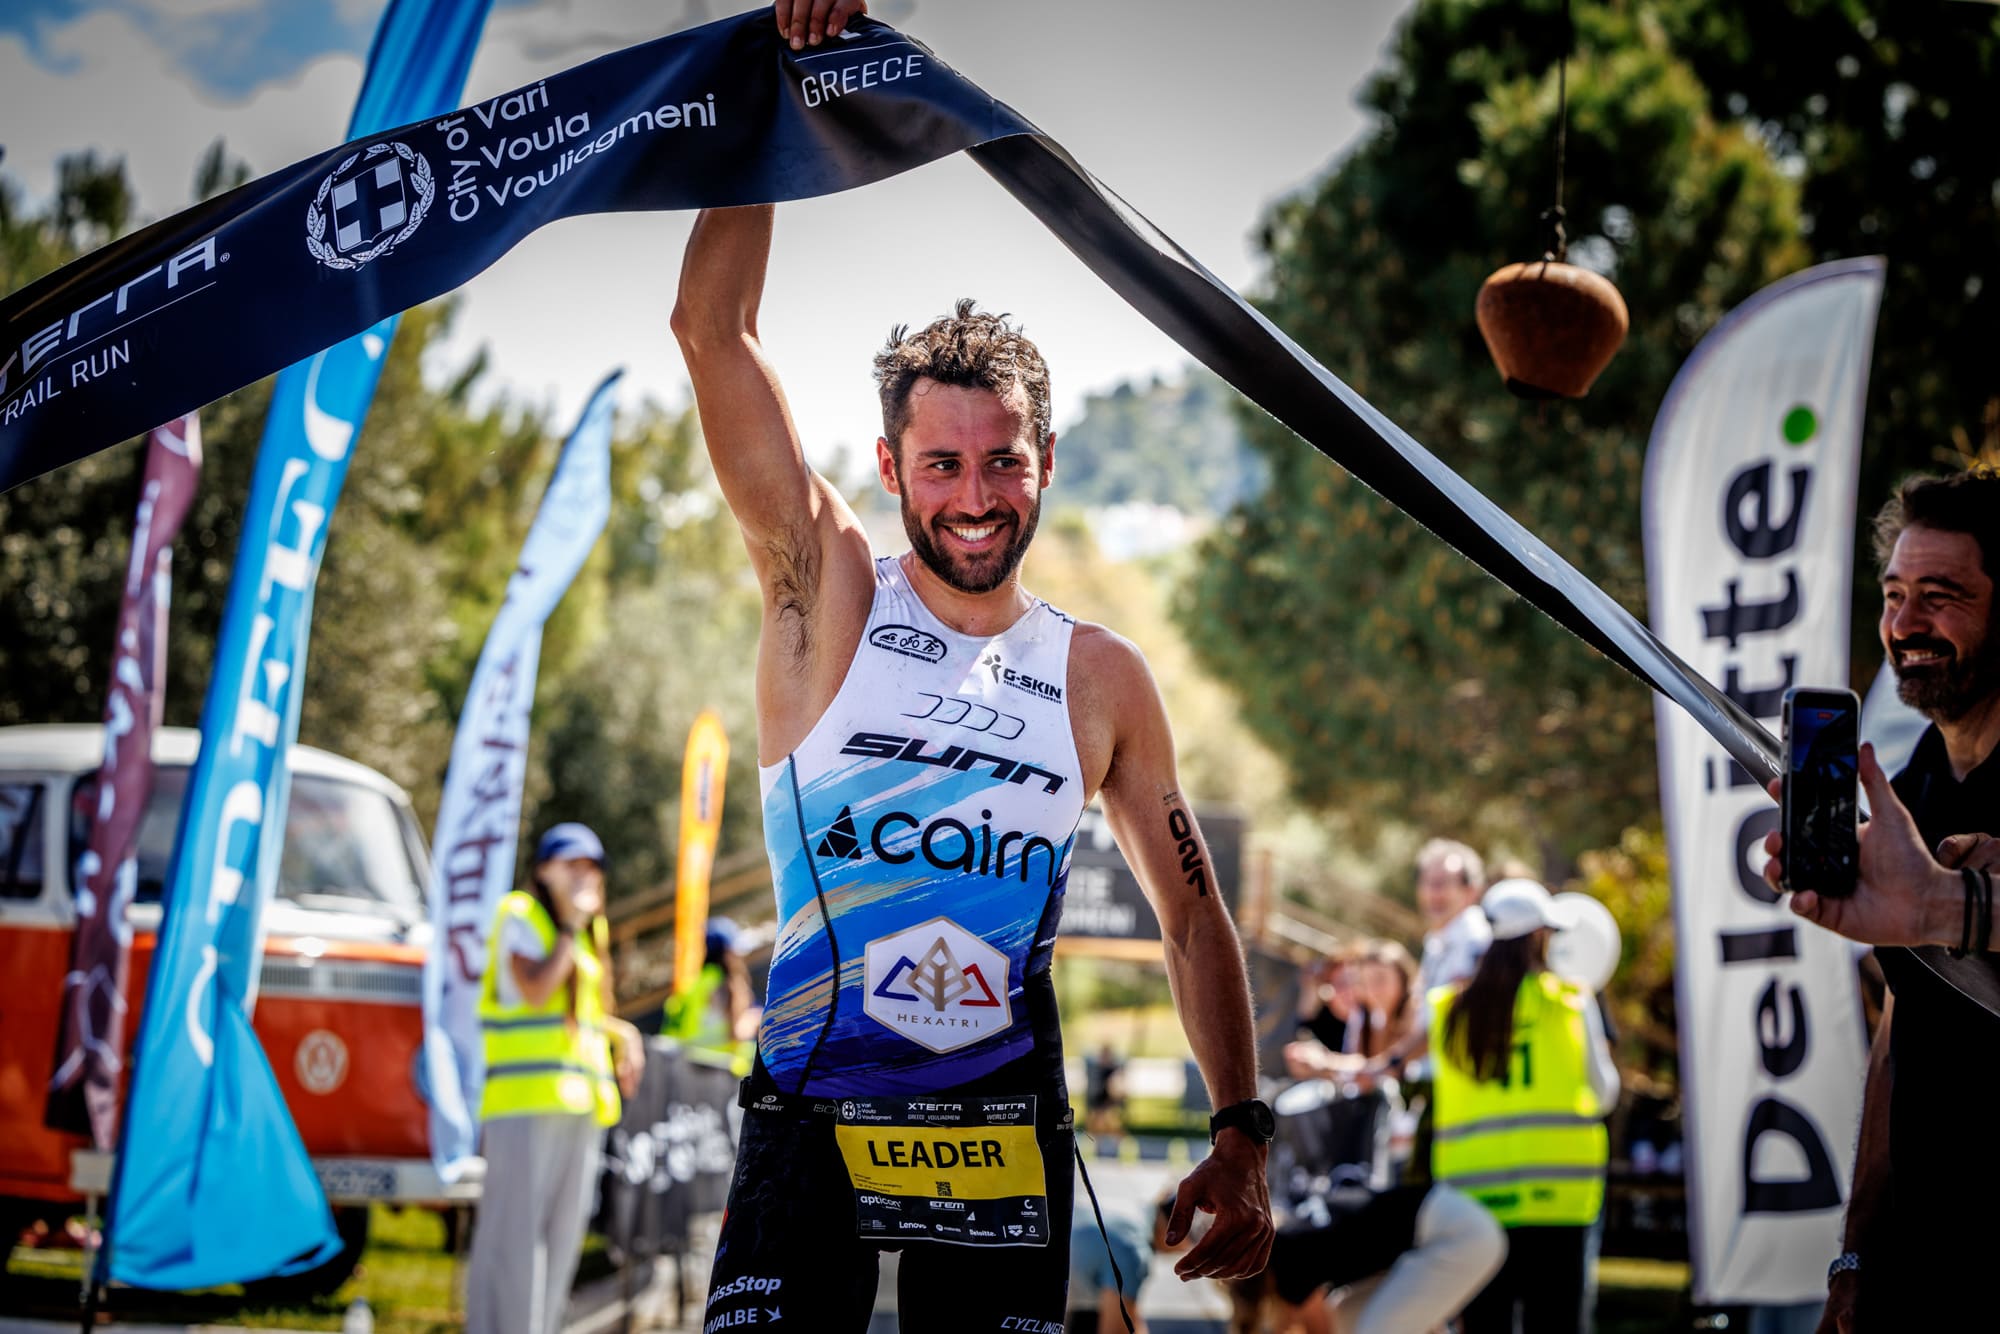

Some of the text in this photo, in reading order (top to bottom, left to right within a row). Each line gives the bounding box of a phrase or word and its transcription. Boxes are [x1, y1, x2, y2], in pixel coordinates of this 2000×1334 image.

[473, 80, 549, 129] Vari
[801, 54, 924, 108] GREECE
[480, 111, 591, 169] Voula
[486, 93, 717, 207] Vouliagmeni
[436, 114, 481, 222] City of
[71, 339, 130, 388] RUN
[1003, 668, 1063, 700] G-SKIN
[871, 809, 1056, 886] cairn
[1168, 808, 1207, 897] 021
[897, 1013, 979, 1028] HEXATRI
[986, 1112, 1020, 1121] WORLD CUP
[867, 1139, 1005, 1169] LEADER
[703, 1307, 758, 1334] WALBE
